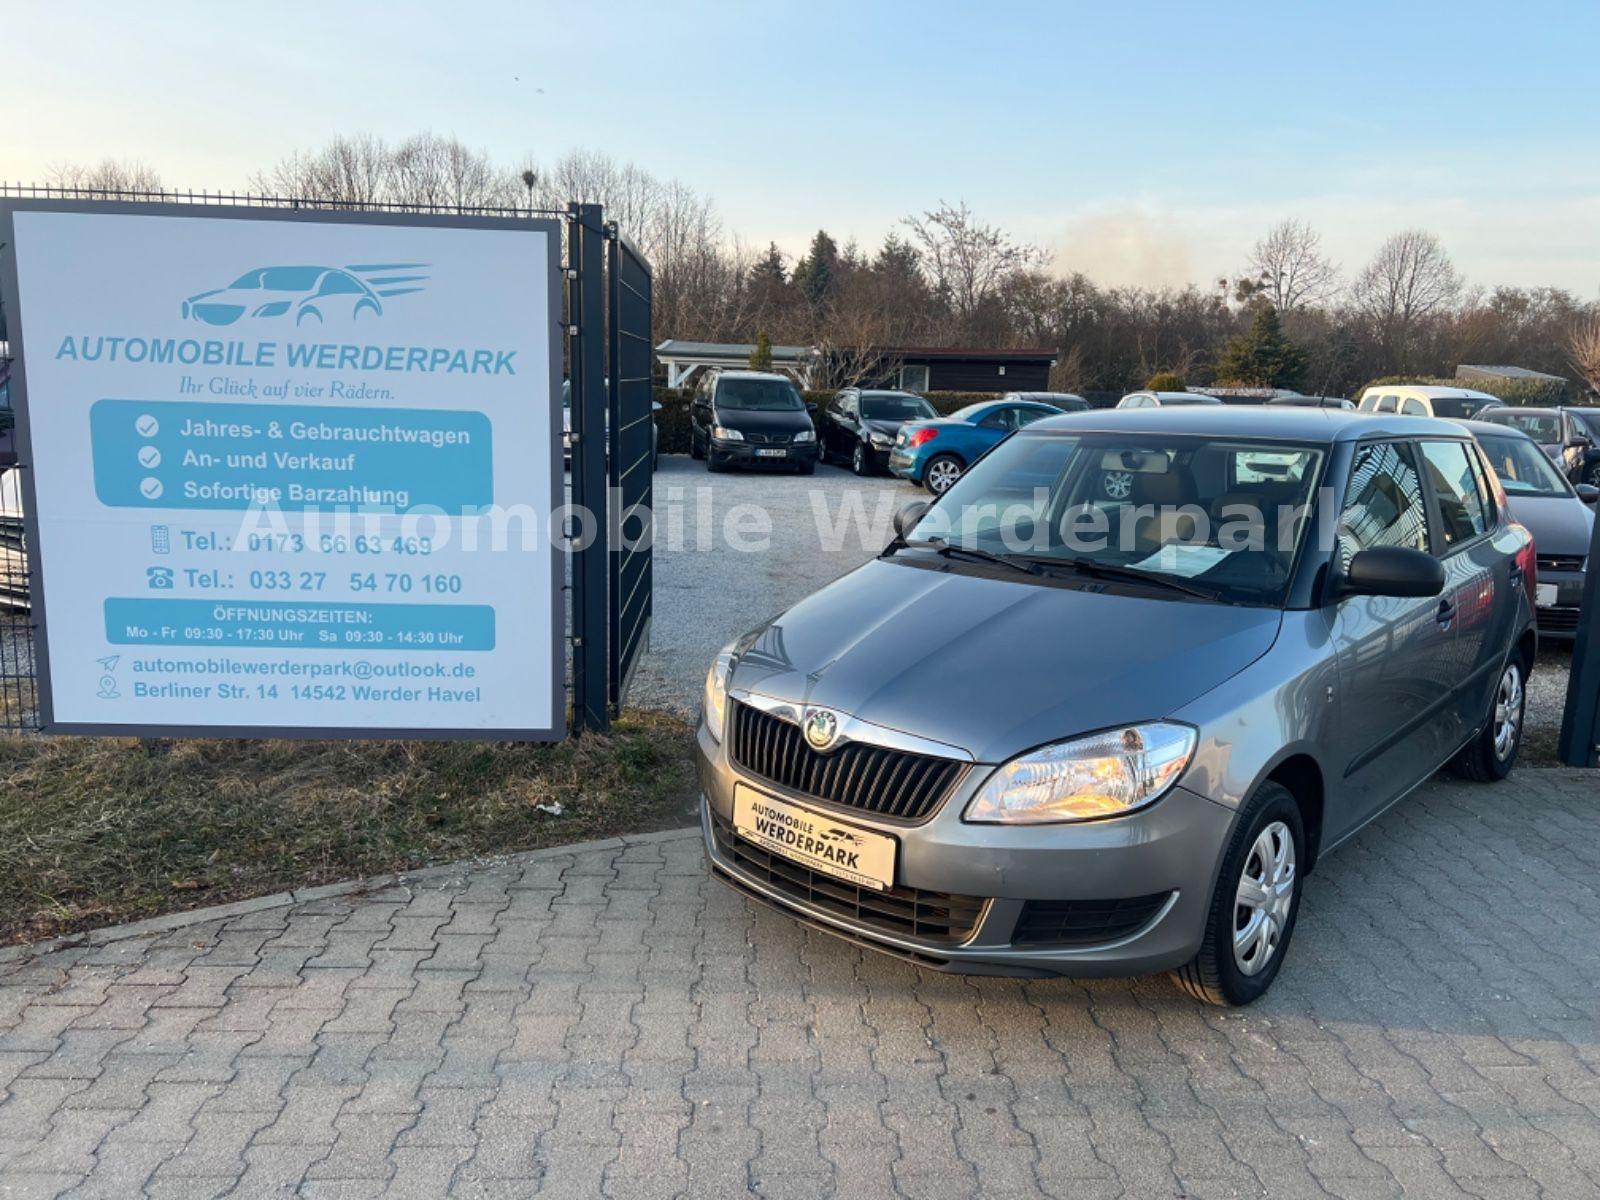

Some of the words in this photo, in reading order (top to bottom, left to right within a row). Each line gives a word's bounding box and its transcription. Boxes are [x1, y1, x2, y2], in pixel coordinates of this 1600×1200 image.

[55, 335, 278, 368] AUTOMOBILE
[286, 343, 518, 376] WERDERPARK
[179, 375, 204, 394] Ihr
[208, 376, 258, 399] Glück
[262, 379, 292, 400] auf
[294, 382, 325, 398] vier
[330, 380, 395, 401] Rädern.
[180, 419, 261, 438] Jahres-
[267, 421, 284, 439] &
[289, 421, 471, 448] Gebrauchtwagen
[182, 450, 221, 467] An-
[226, 451, 268, 469] und
[273, 452, 356, 471] Verkauf
[183, 481, 282, 504] Sofortige
[287, 483, 410, 508] Barzahlung
[181, 531, 232, 551] Tel.:
[249, 532, 305, 553] 0173
[319, 534, 346, 554] 66
[354, 535, 383, 555] 63
[392, 536, 432, 556] 469
[184, 569, 235, 589] Tel.:
[249, 570, 292, 590] 033
[300, 571, 328, 591] 27
[349, 572, 378, 592] 54
[385, 573, 413, 593] 70
[421, 574, 463, 594] 160
[213, 604, 373, 624] ÖFFNUNGSZEITEN:
[126, 626, 149, 639] Mo
[160, 626, 177, 639] Fr
[184, 627, 223, 640] 09:30
[236, 628, 274, 641] 17:30
[278, 628, 304, 641] Uhr
[318, 629, 338, 642] Sa
[345, 630, 384, 643] 09:30
[397, 631, 434, 644] 14:30
[438, 632, 464, 644] Uhr
[132, 658, 476, 680] automobilewerderpark@outlook.de
[134, 682, 212, 698] Berliner
[217, 683, 250, 699] Str.
[256, 684, 279, 699] 14
[290, 685, 347, 701] 14542
[352, 685, 422, 702] Werder
[427, 686, 481, 703] Havel
[751, 802, 813, 835] AUTOMOBILE
[755, 816, 860, 869] WERDERPARK
